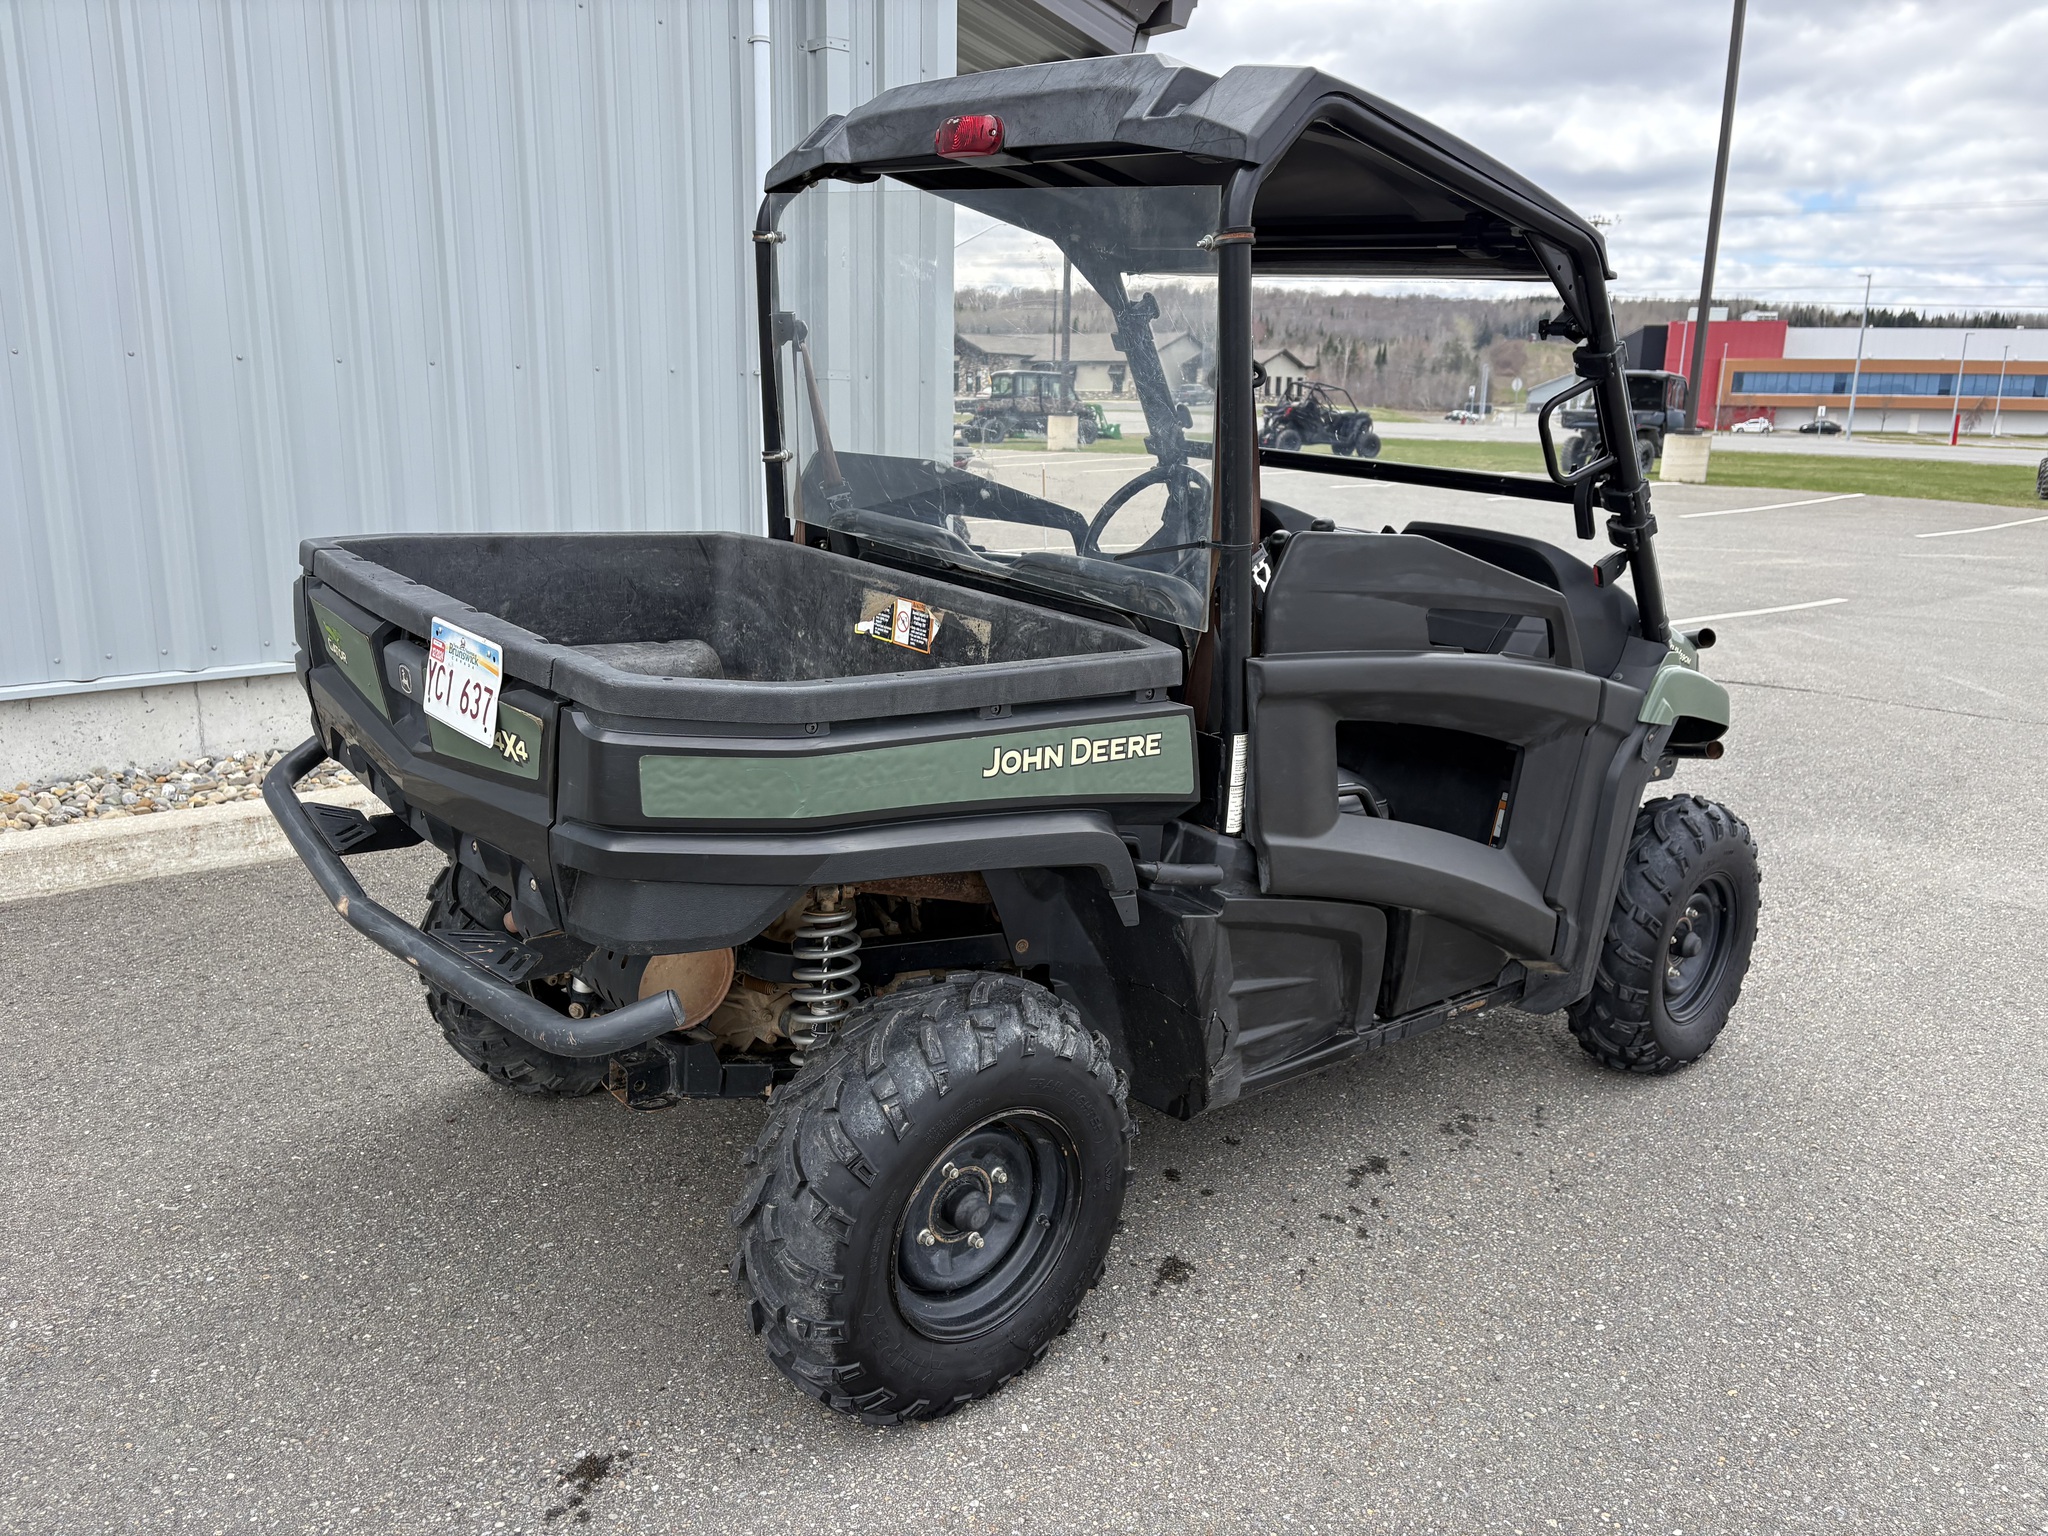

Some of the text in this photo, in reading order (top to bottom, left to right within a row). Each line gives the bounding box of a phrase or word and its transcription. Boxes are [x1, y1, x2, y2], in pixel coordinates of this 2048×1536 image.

[448, 642, 479, 666] Brunswick
[460, 678, 494, 726] 637
[982, 731, 1162, 778] JOHN DEERE
[1065, 1085, 1106, 1134] FIGHTER
